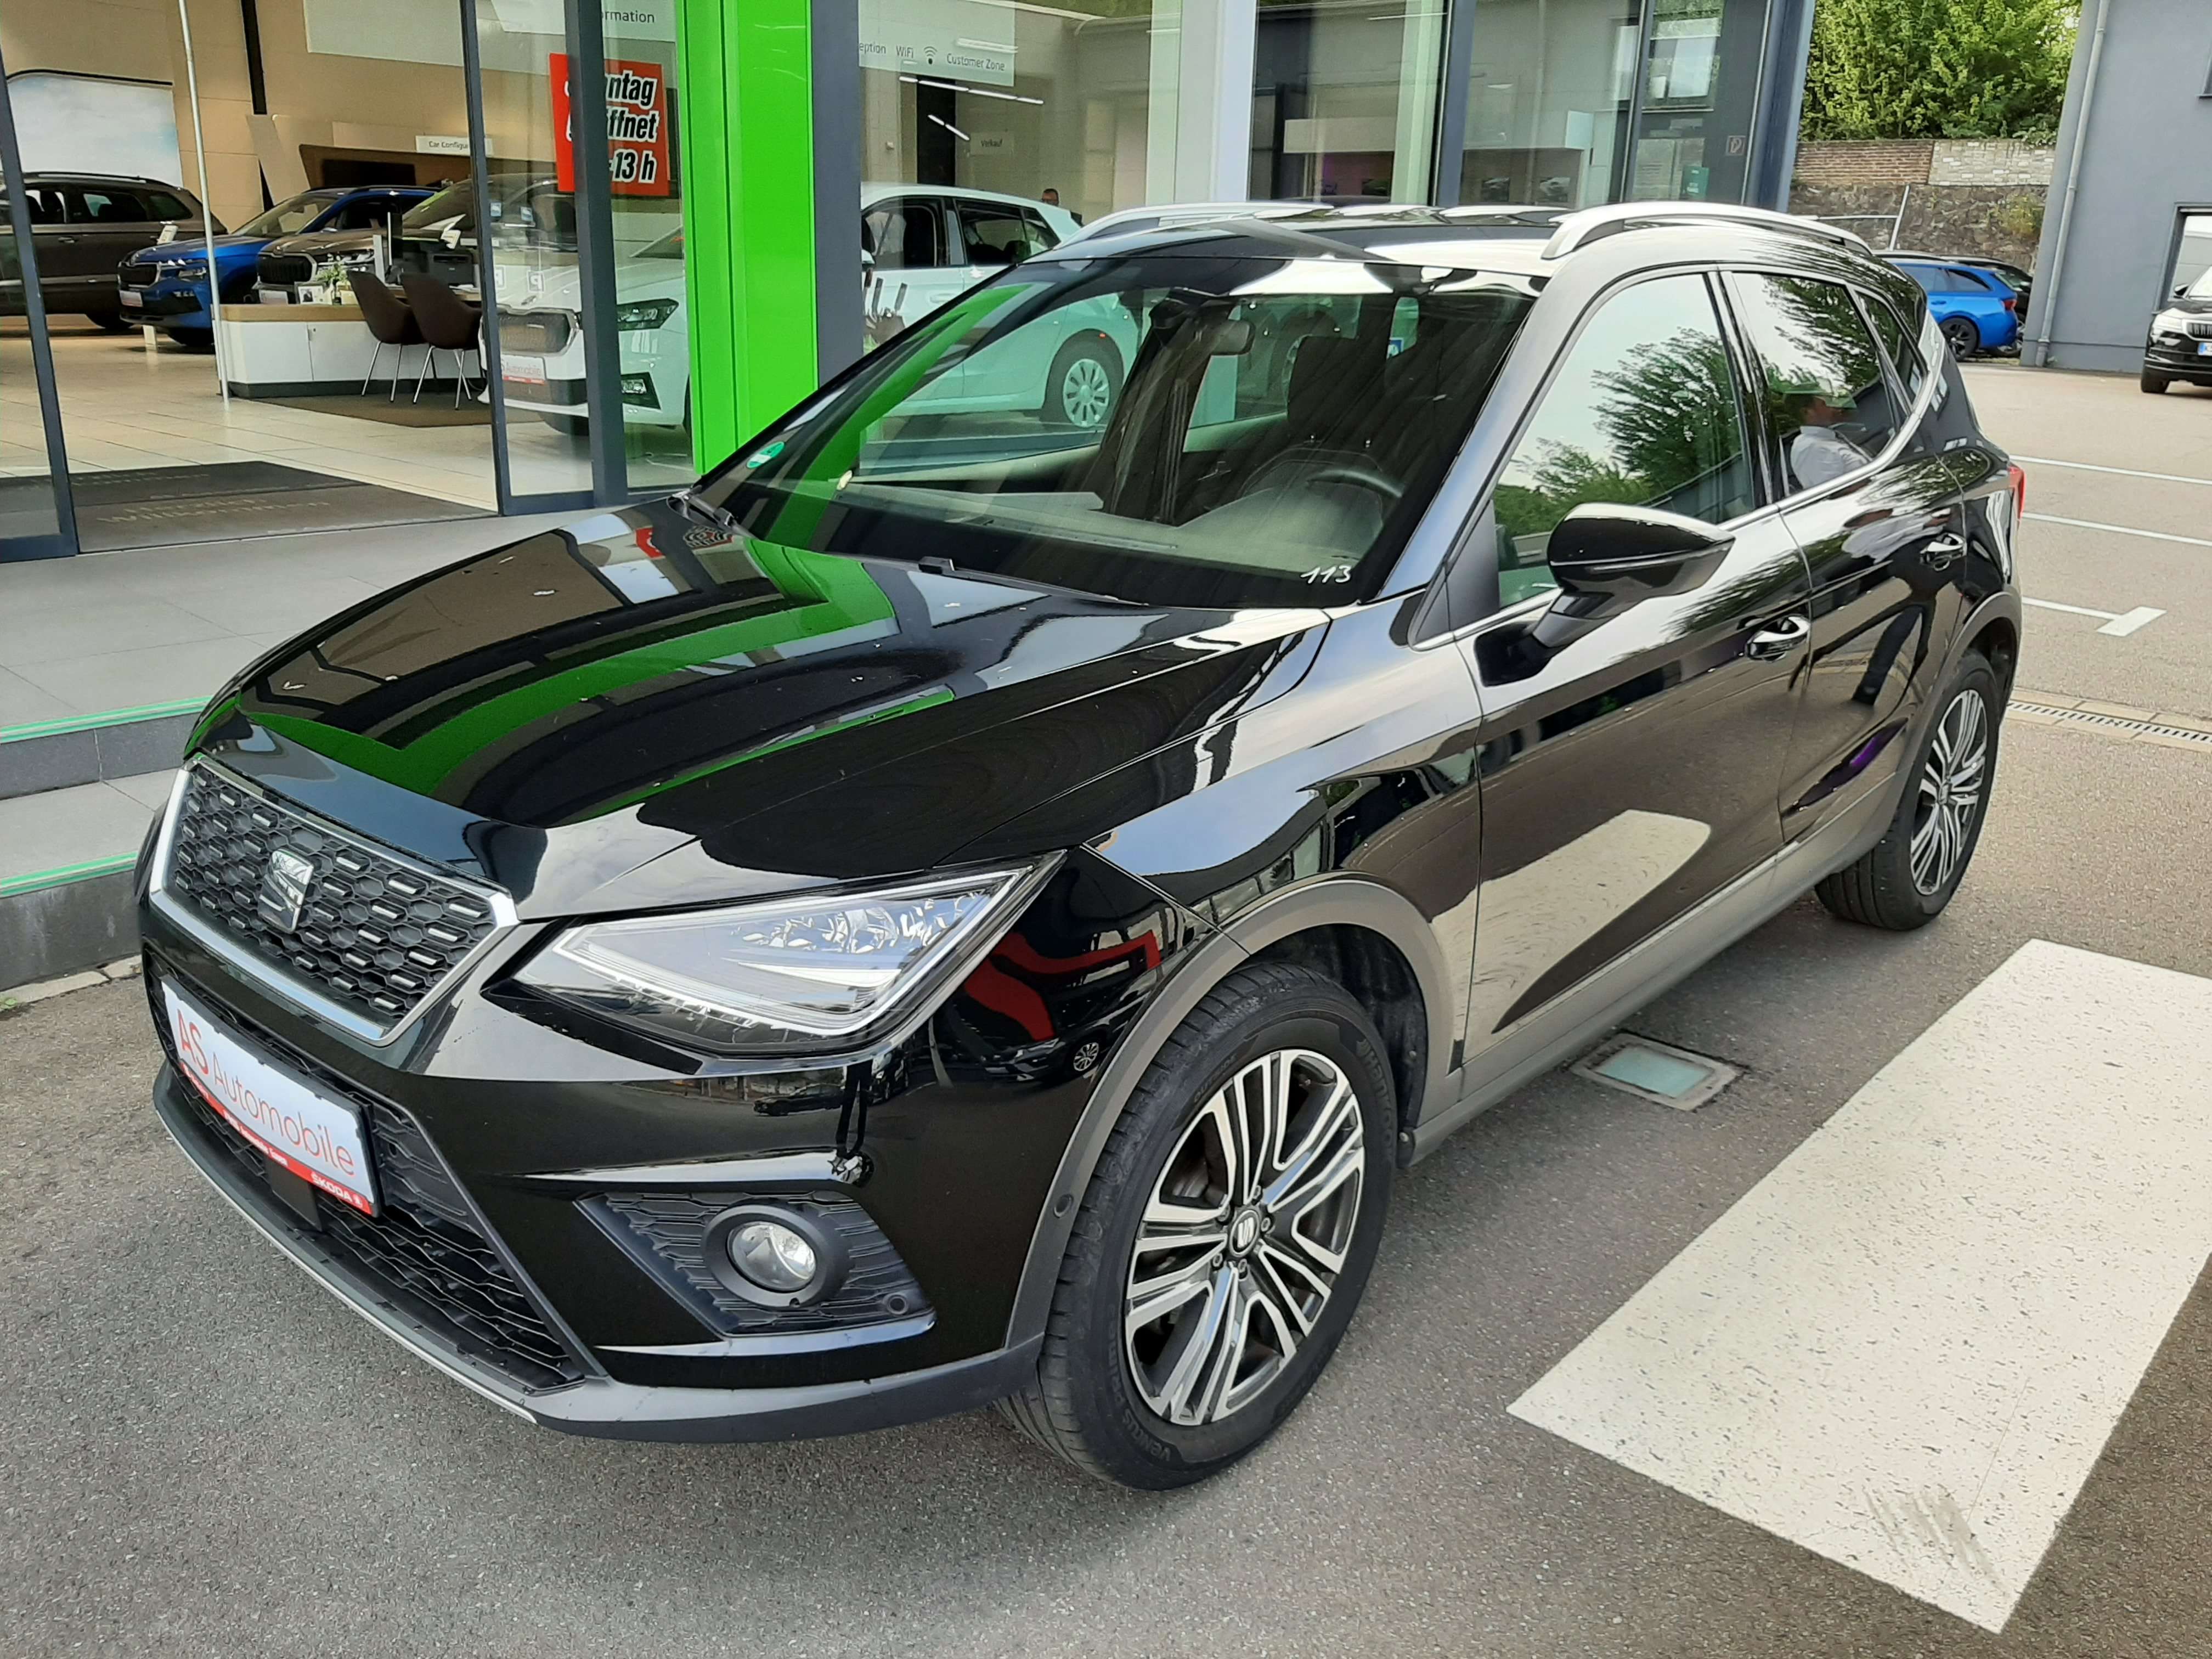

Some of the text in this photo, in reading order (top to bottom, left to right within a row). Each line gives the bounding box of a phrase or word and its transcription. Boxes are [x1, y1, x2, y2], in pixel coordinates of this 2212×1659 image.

[603, 10, 654, 23] rmation
[859, 42, 1005, 71] eption WiFi Customer Zone
[605, 70, 657, 109] ntag
[606, 106, 659, 143] ffnet
[441, 141, 469, 150] Configu
[639, 150, 657, 184] h
[1300, 564, 1352, 584] 113
[177, 1008, 209, 1075] AS
[213, 1051, 355, 1175] Automobile
